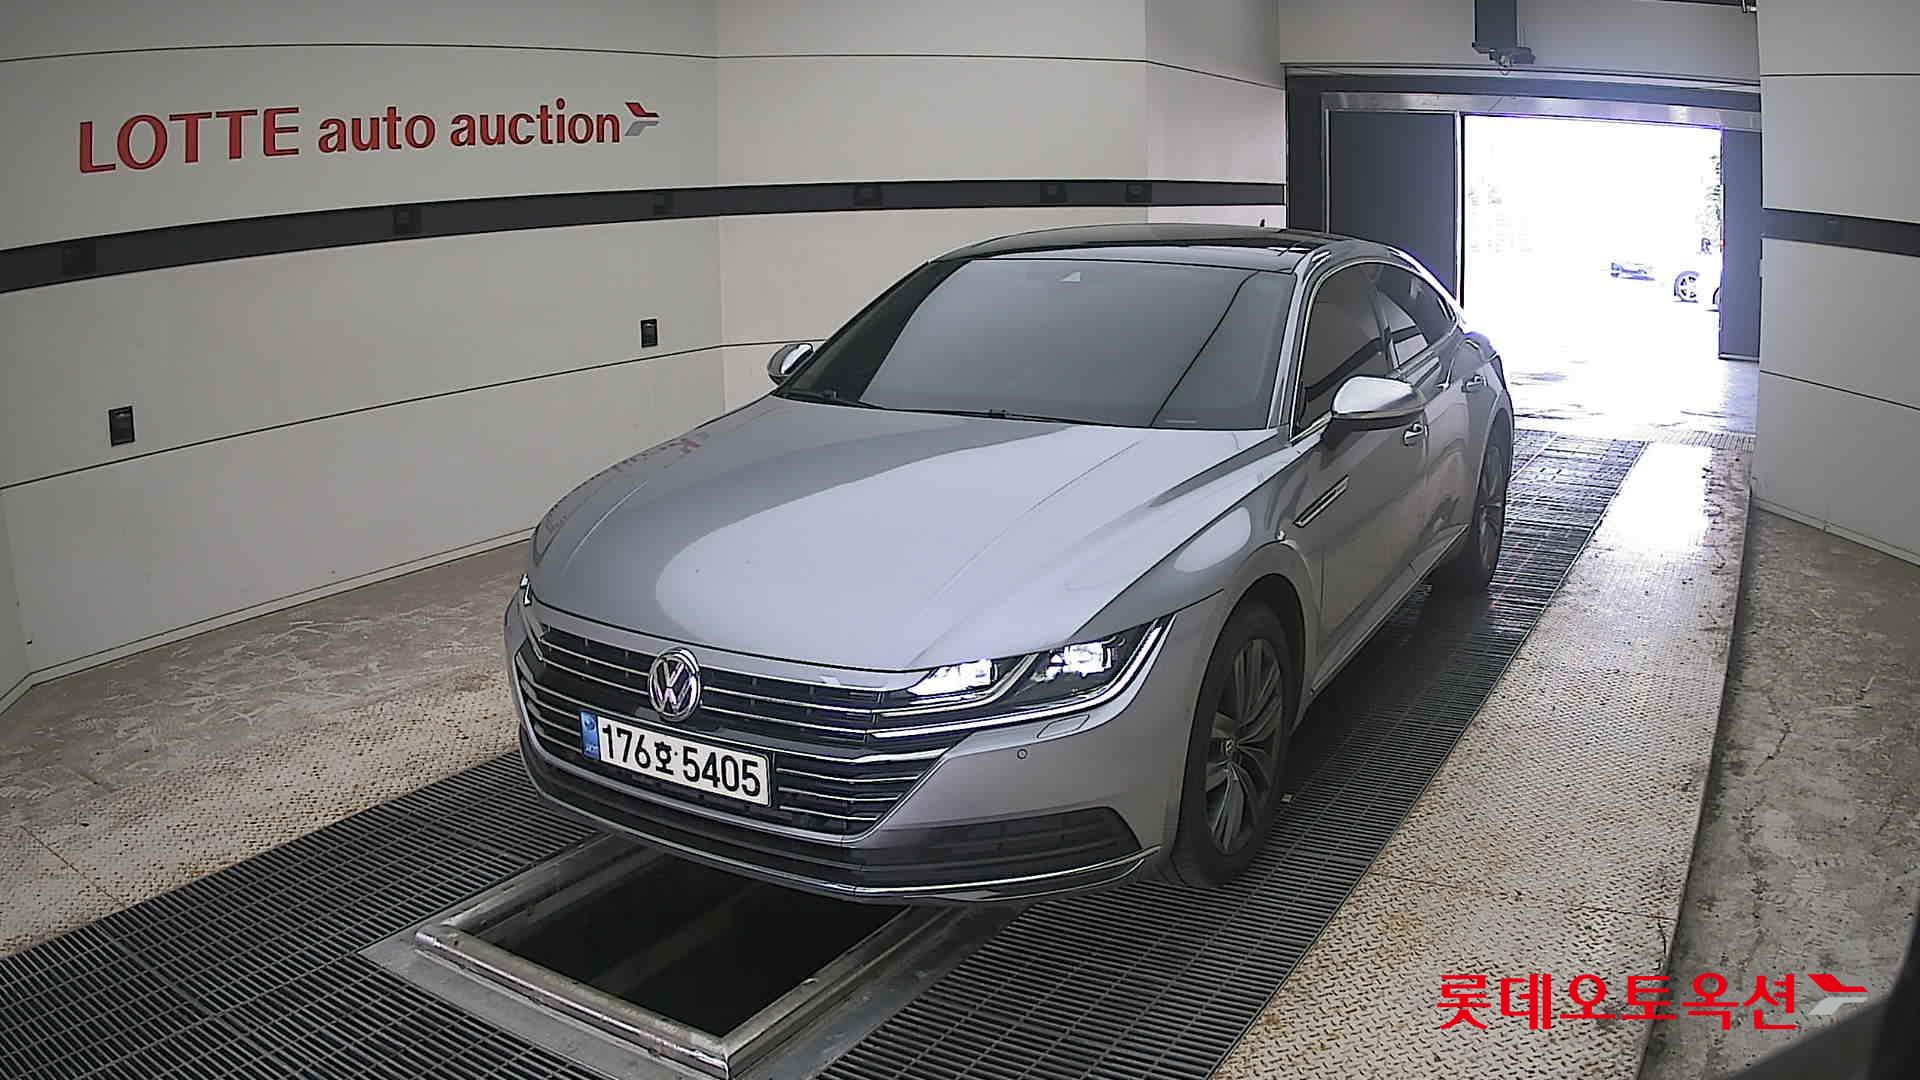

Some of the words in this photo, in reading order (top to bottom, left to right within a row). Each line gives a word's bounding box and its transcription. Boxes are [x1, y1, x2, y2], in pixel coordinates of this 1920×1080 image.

[79, 107, 300, 174] LOTTE
[318, 105, 437, 154] auto
[449, 98, 621, 146] auction
